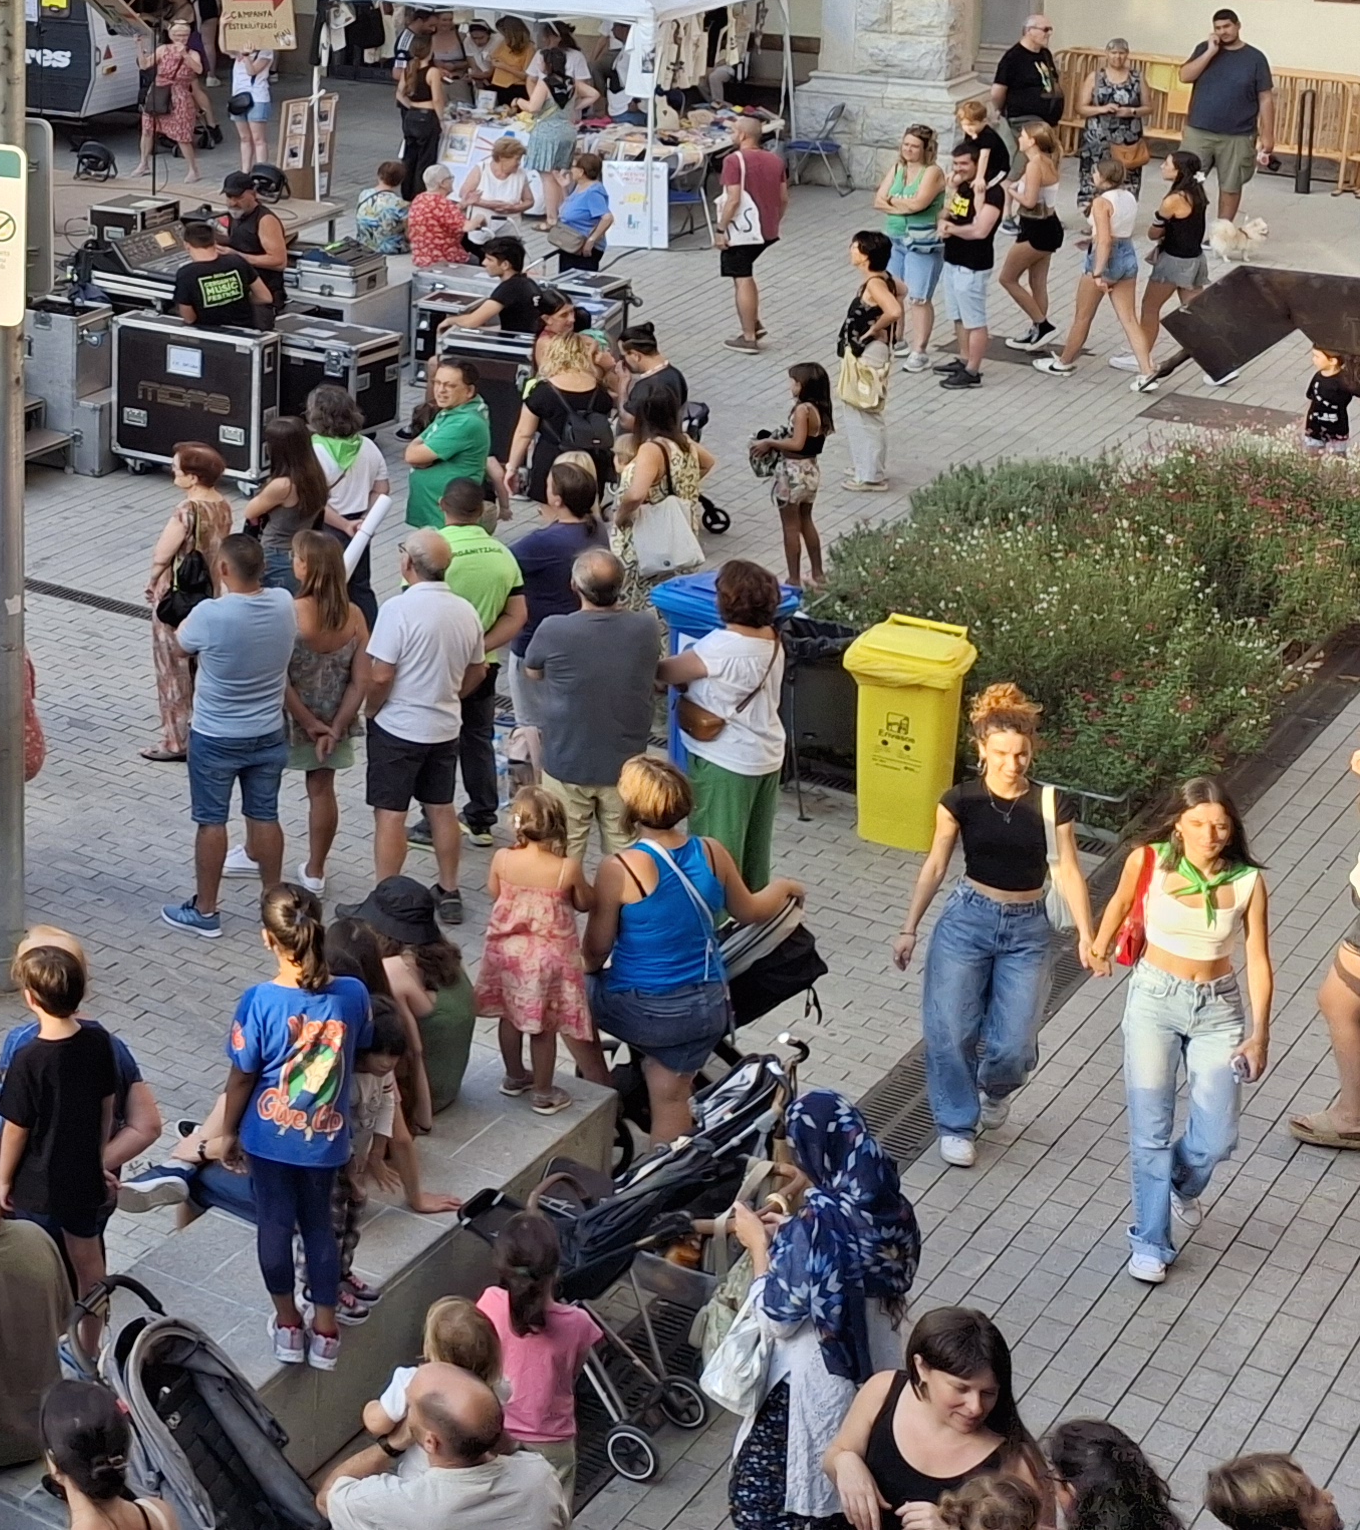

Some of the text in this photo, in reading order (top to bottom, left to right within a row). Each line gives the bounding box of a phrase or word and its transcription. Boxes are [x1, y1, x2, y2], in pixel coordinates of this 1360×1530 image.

[206, 282, 238, 295] MUSIC
[207, 290, 240, 302] FESTIVAL
[257, 1088, 308, 1130] Give
